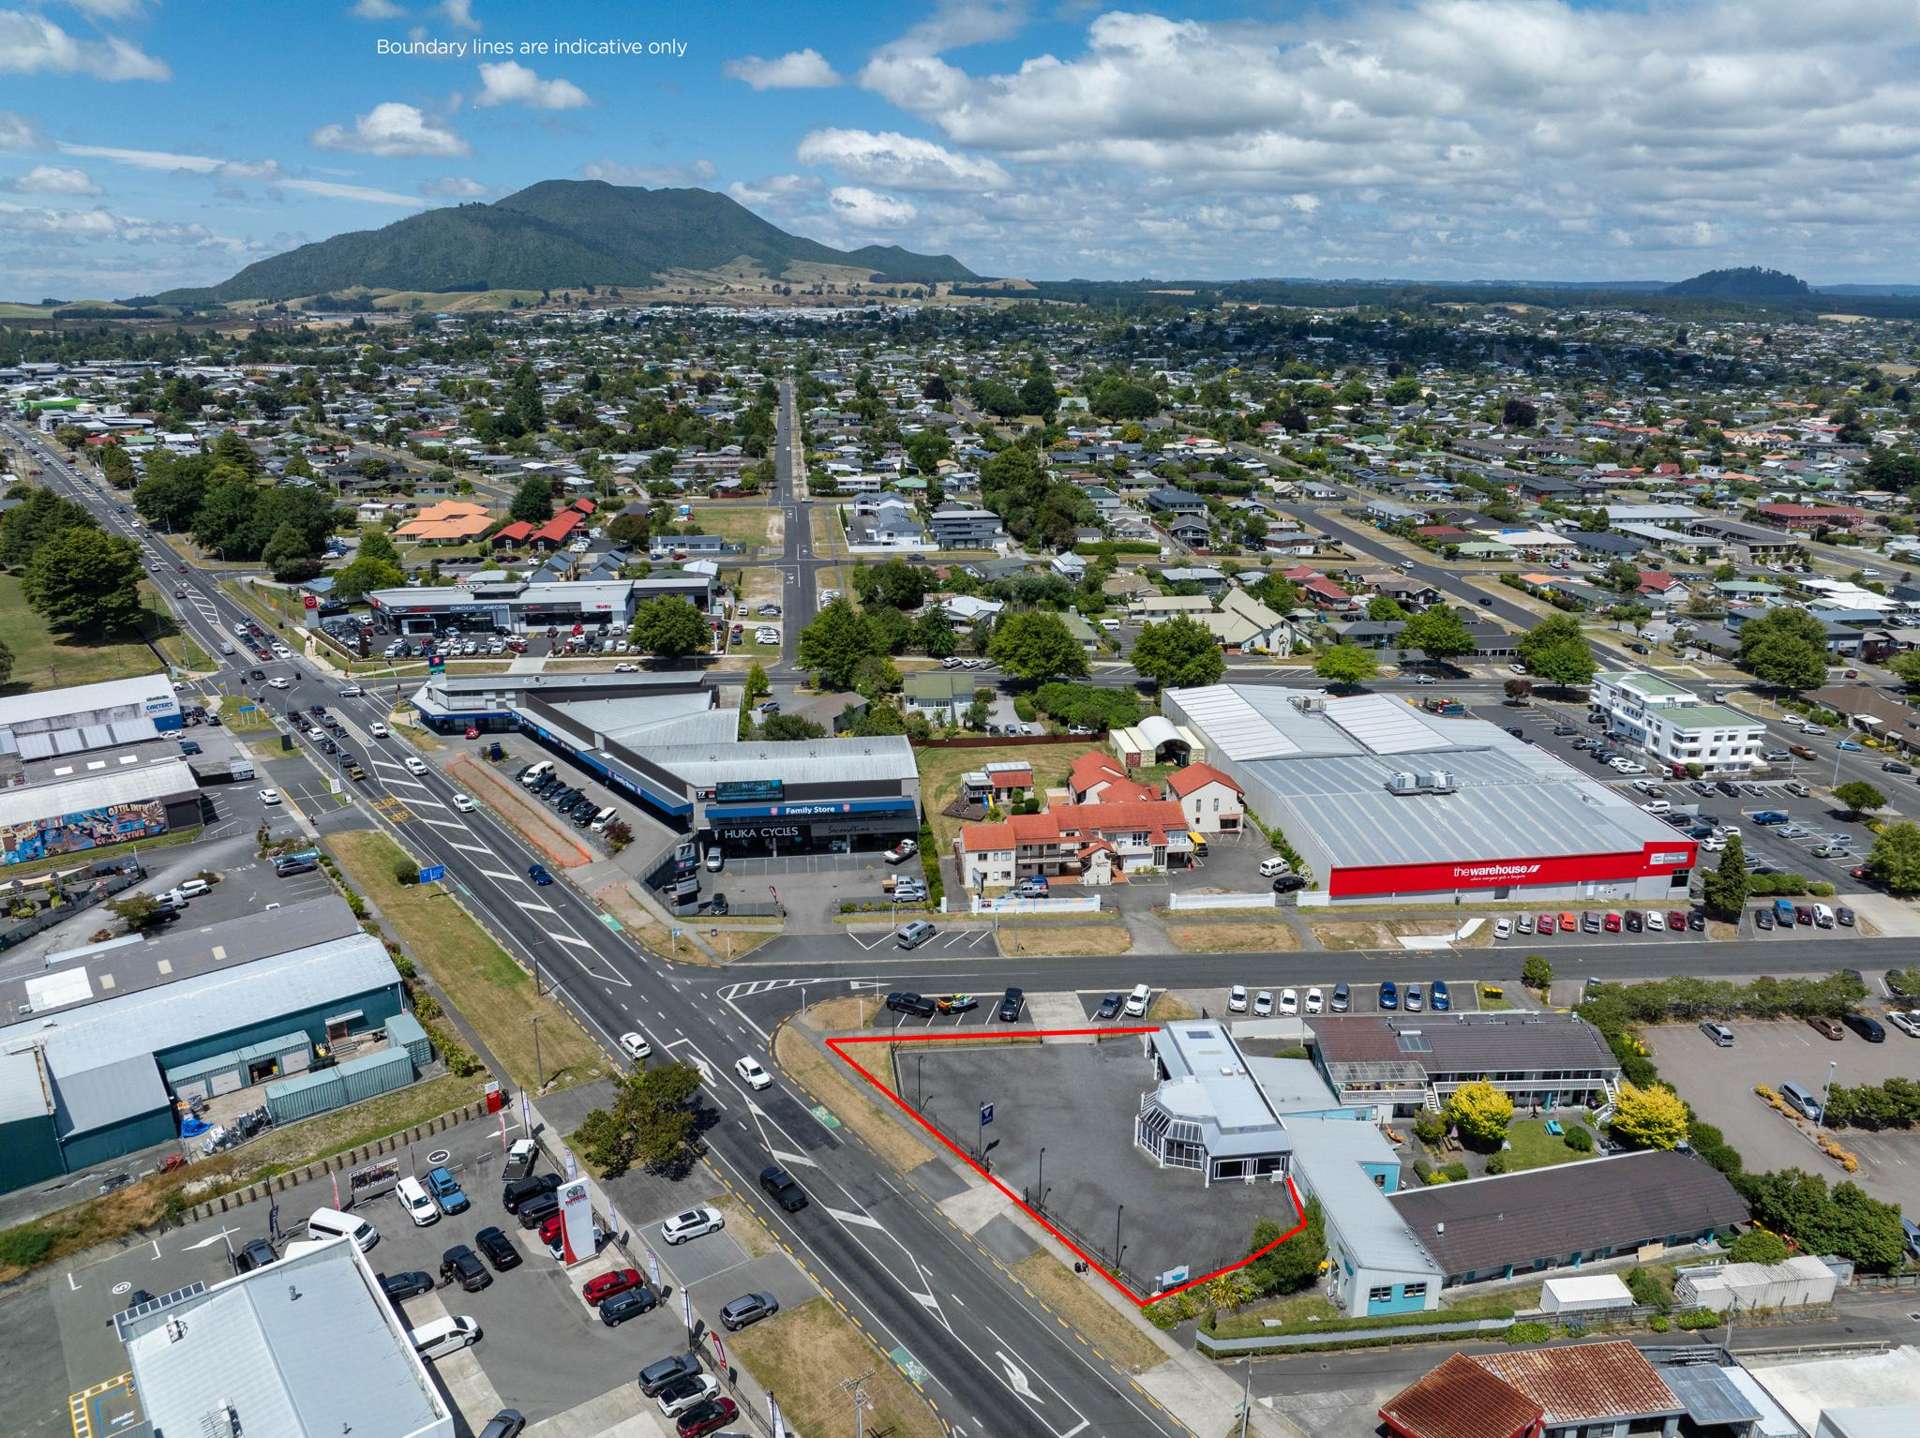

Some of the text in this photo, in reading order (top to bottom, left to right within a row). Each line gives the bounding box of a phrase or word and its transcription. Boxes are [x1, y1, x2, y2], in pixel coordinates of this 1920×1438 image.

[785, 805, 836, 815] Family Store
[724, 826, 799, 839] HUKA CYCLES
